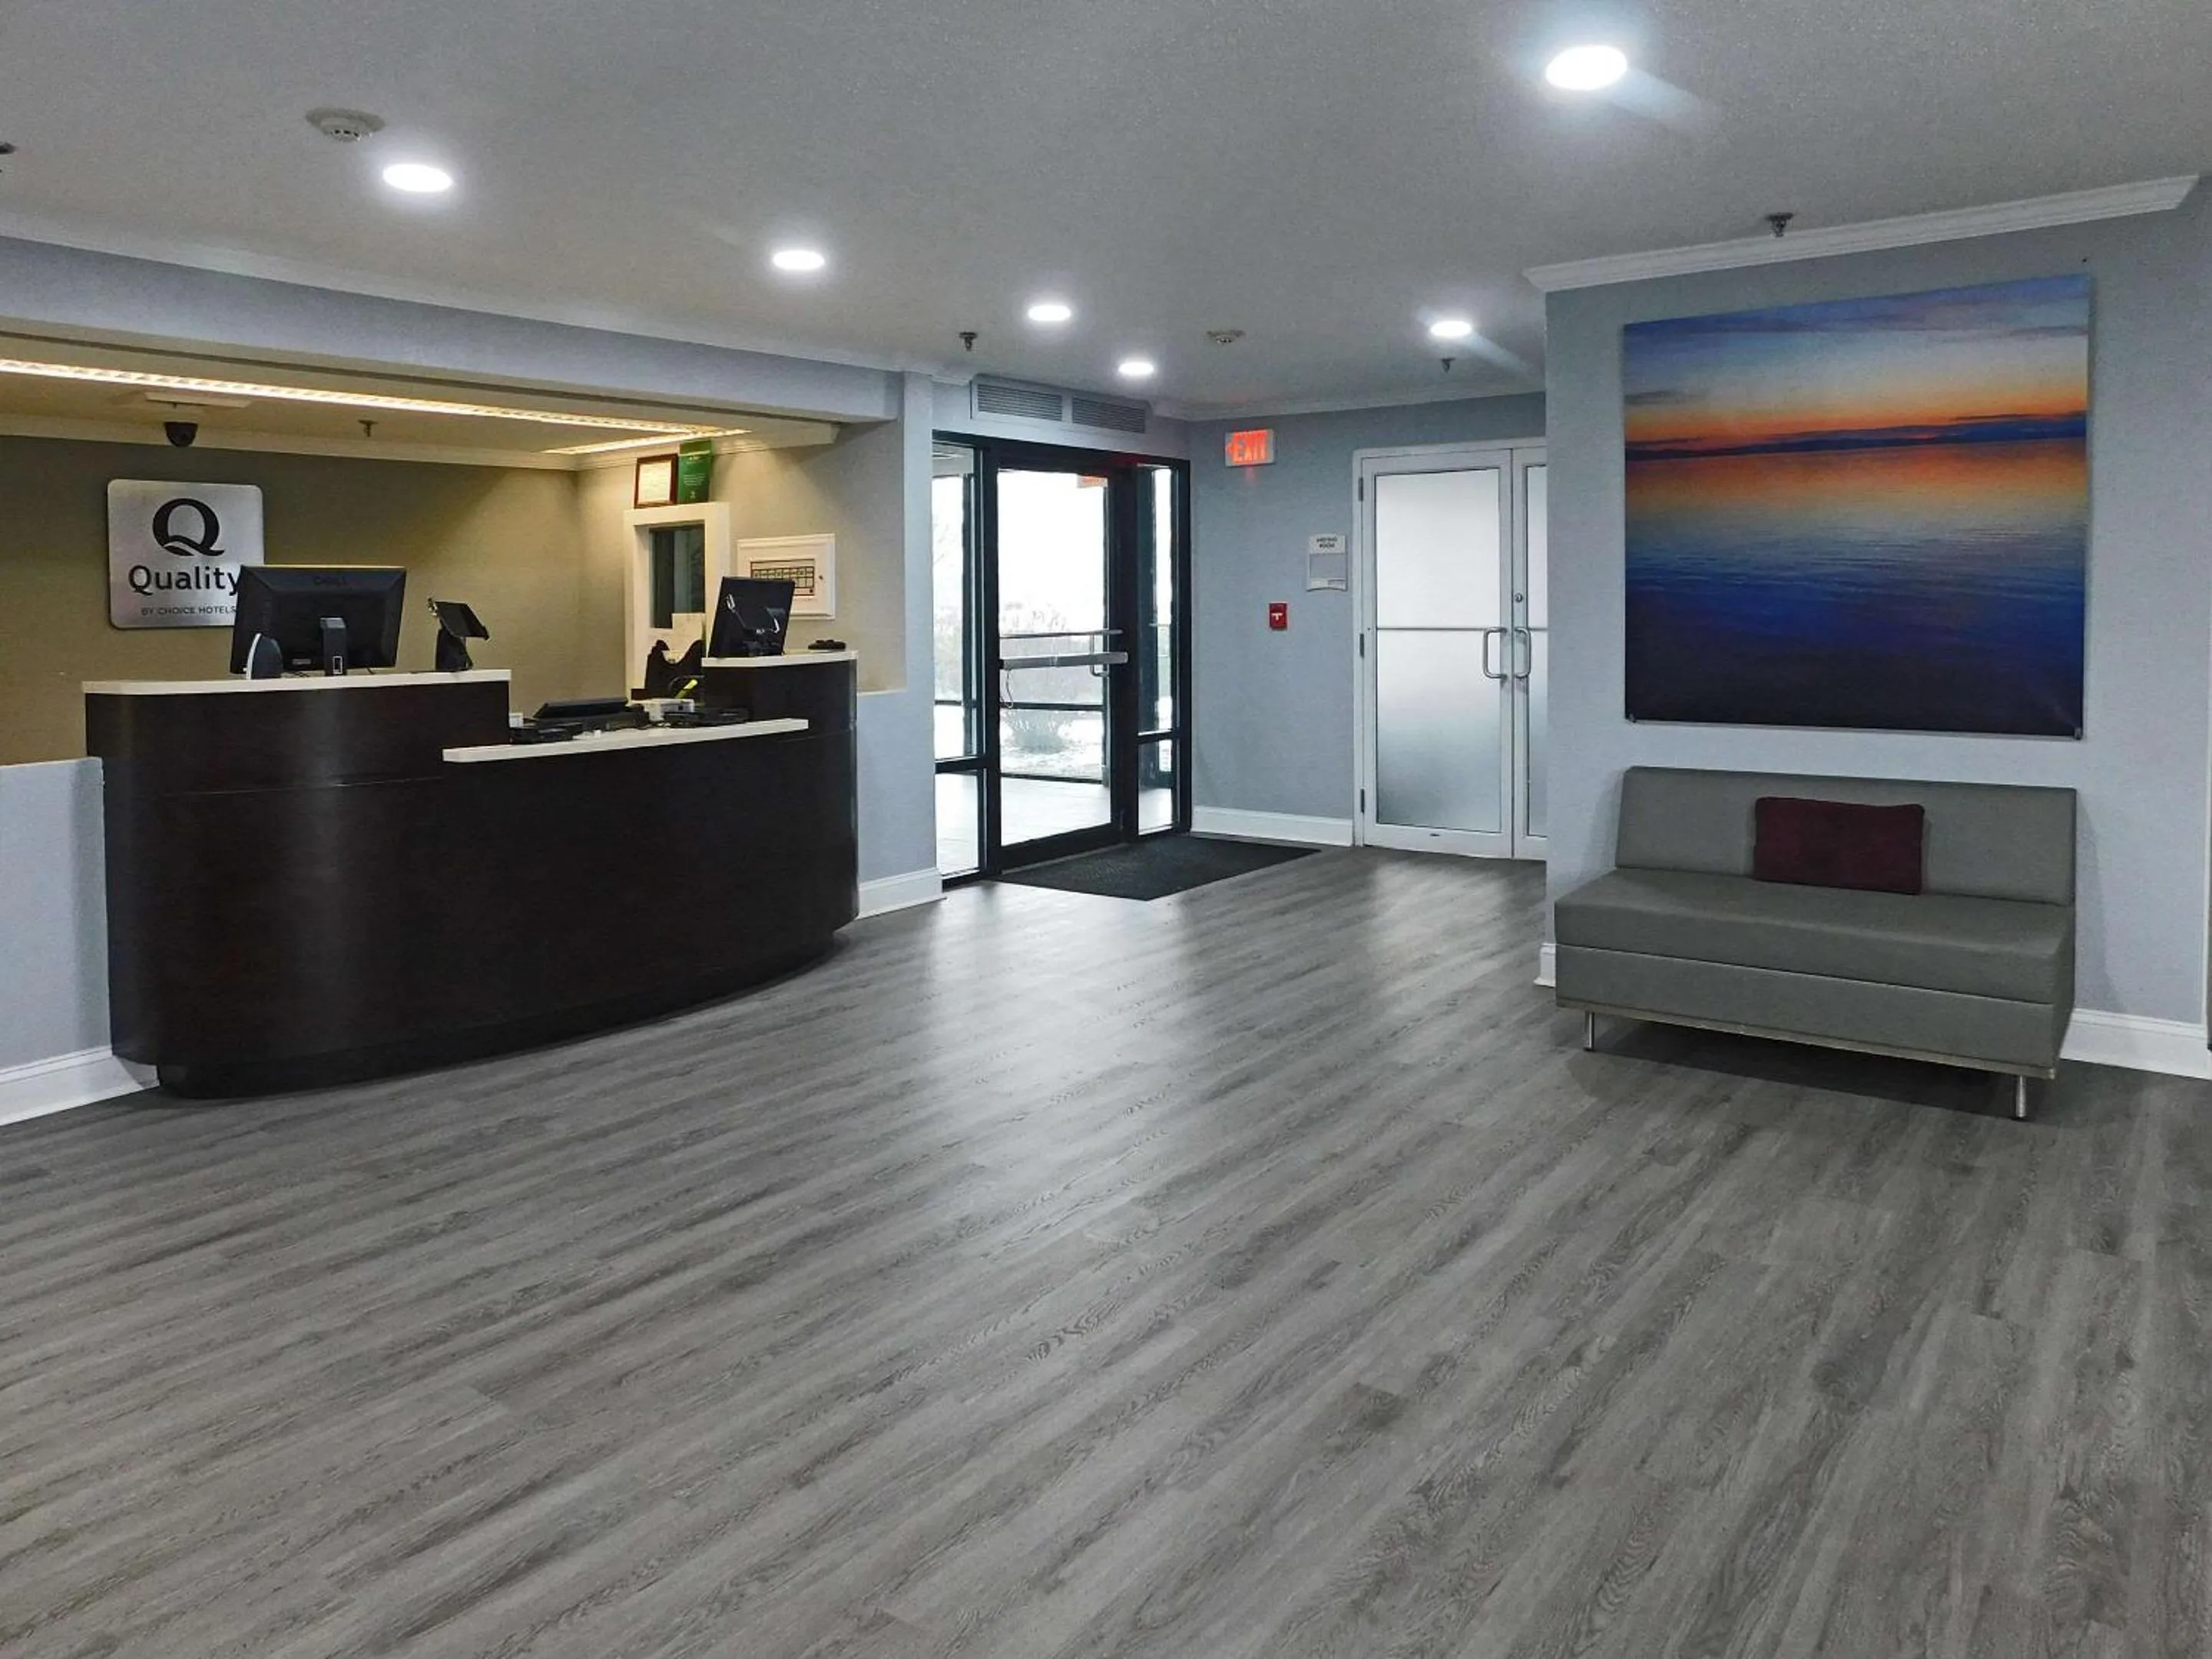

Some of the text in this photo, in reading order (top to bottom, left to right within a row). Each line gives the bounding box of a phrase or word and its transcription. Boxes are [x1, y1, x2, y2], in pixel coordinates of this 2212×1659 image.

[1233, 431, 1266, 461] EXIT
[153, 498, 225, 557] Q
[128, 565, 240, 596] Quality
[141, 606, 154, 615] BY
[157, 606, 196, 614] CHOICE
